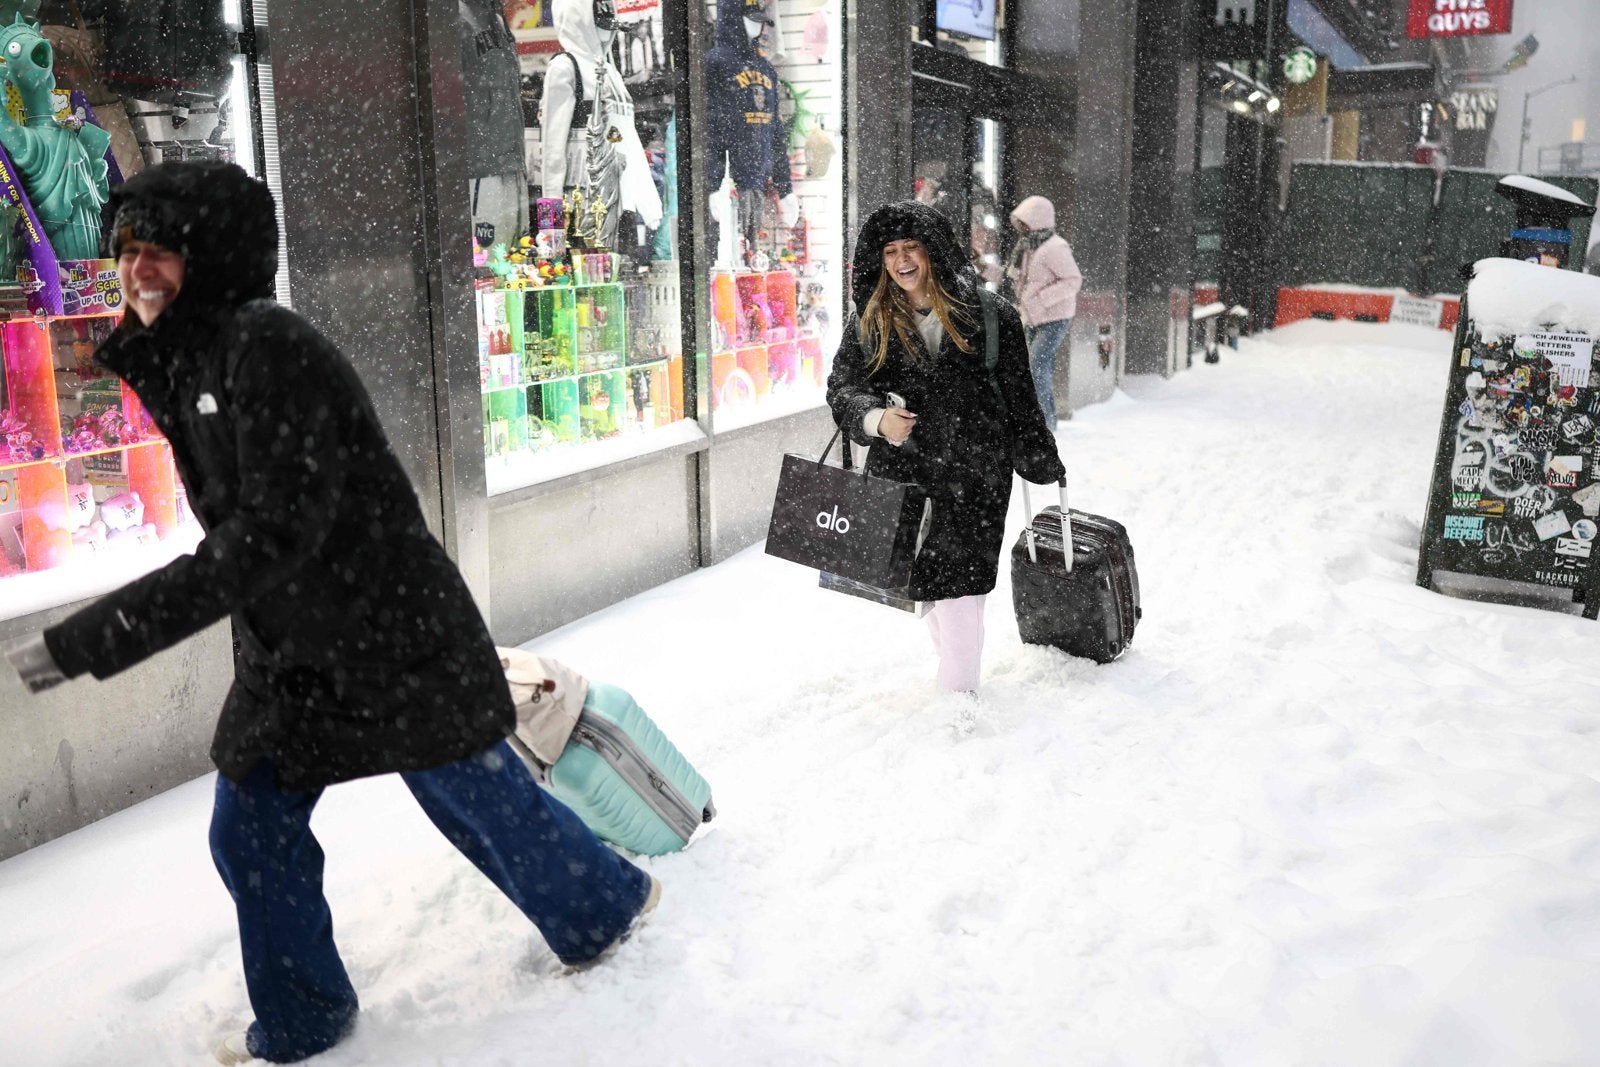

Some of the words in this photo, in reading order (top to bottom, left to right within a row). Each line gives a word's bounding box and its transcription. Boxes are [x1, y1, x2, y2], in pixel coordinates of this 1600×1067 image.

[1428, 11, 1490, 32] GUYS
[735, 70, 773, 90] NYPD
[7, 184, 20, 202] FOR
[17, 202, 41, 244] FREEDOM!
[476, 226, 494, 238] NYC
[98, 271, 117, 280] HEAR
[96, 279, 121, 293] SCRE
[81, 296, 91, 306] UP
[93, 294, 103, 303] TO
[105, 292, 120, 304] 60
[1536, 341, 1572, 349] SETTERS
[1549, 335, 1591, 343] JEWELERS
[1536, 349, 1576, 358] OLISHERS
[1514, 497, 1542, 510] DOER
[816, 504, 850, 534] alo
[1514, 505, 1536, 519] RITA
[1445, 515, 1485, 529] DISCOUNT
[1444, 527, 1484, 541] BEEPERS
[1535, 570, 1579, 583] BLACKBOX
